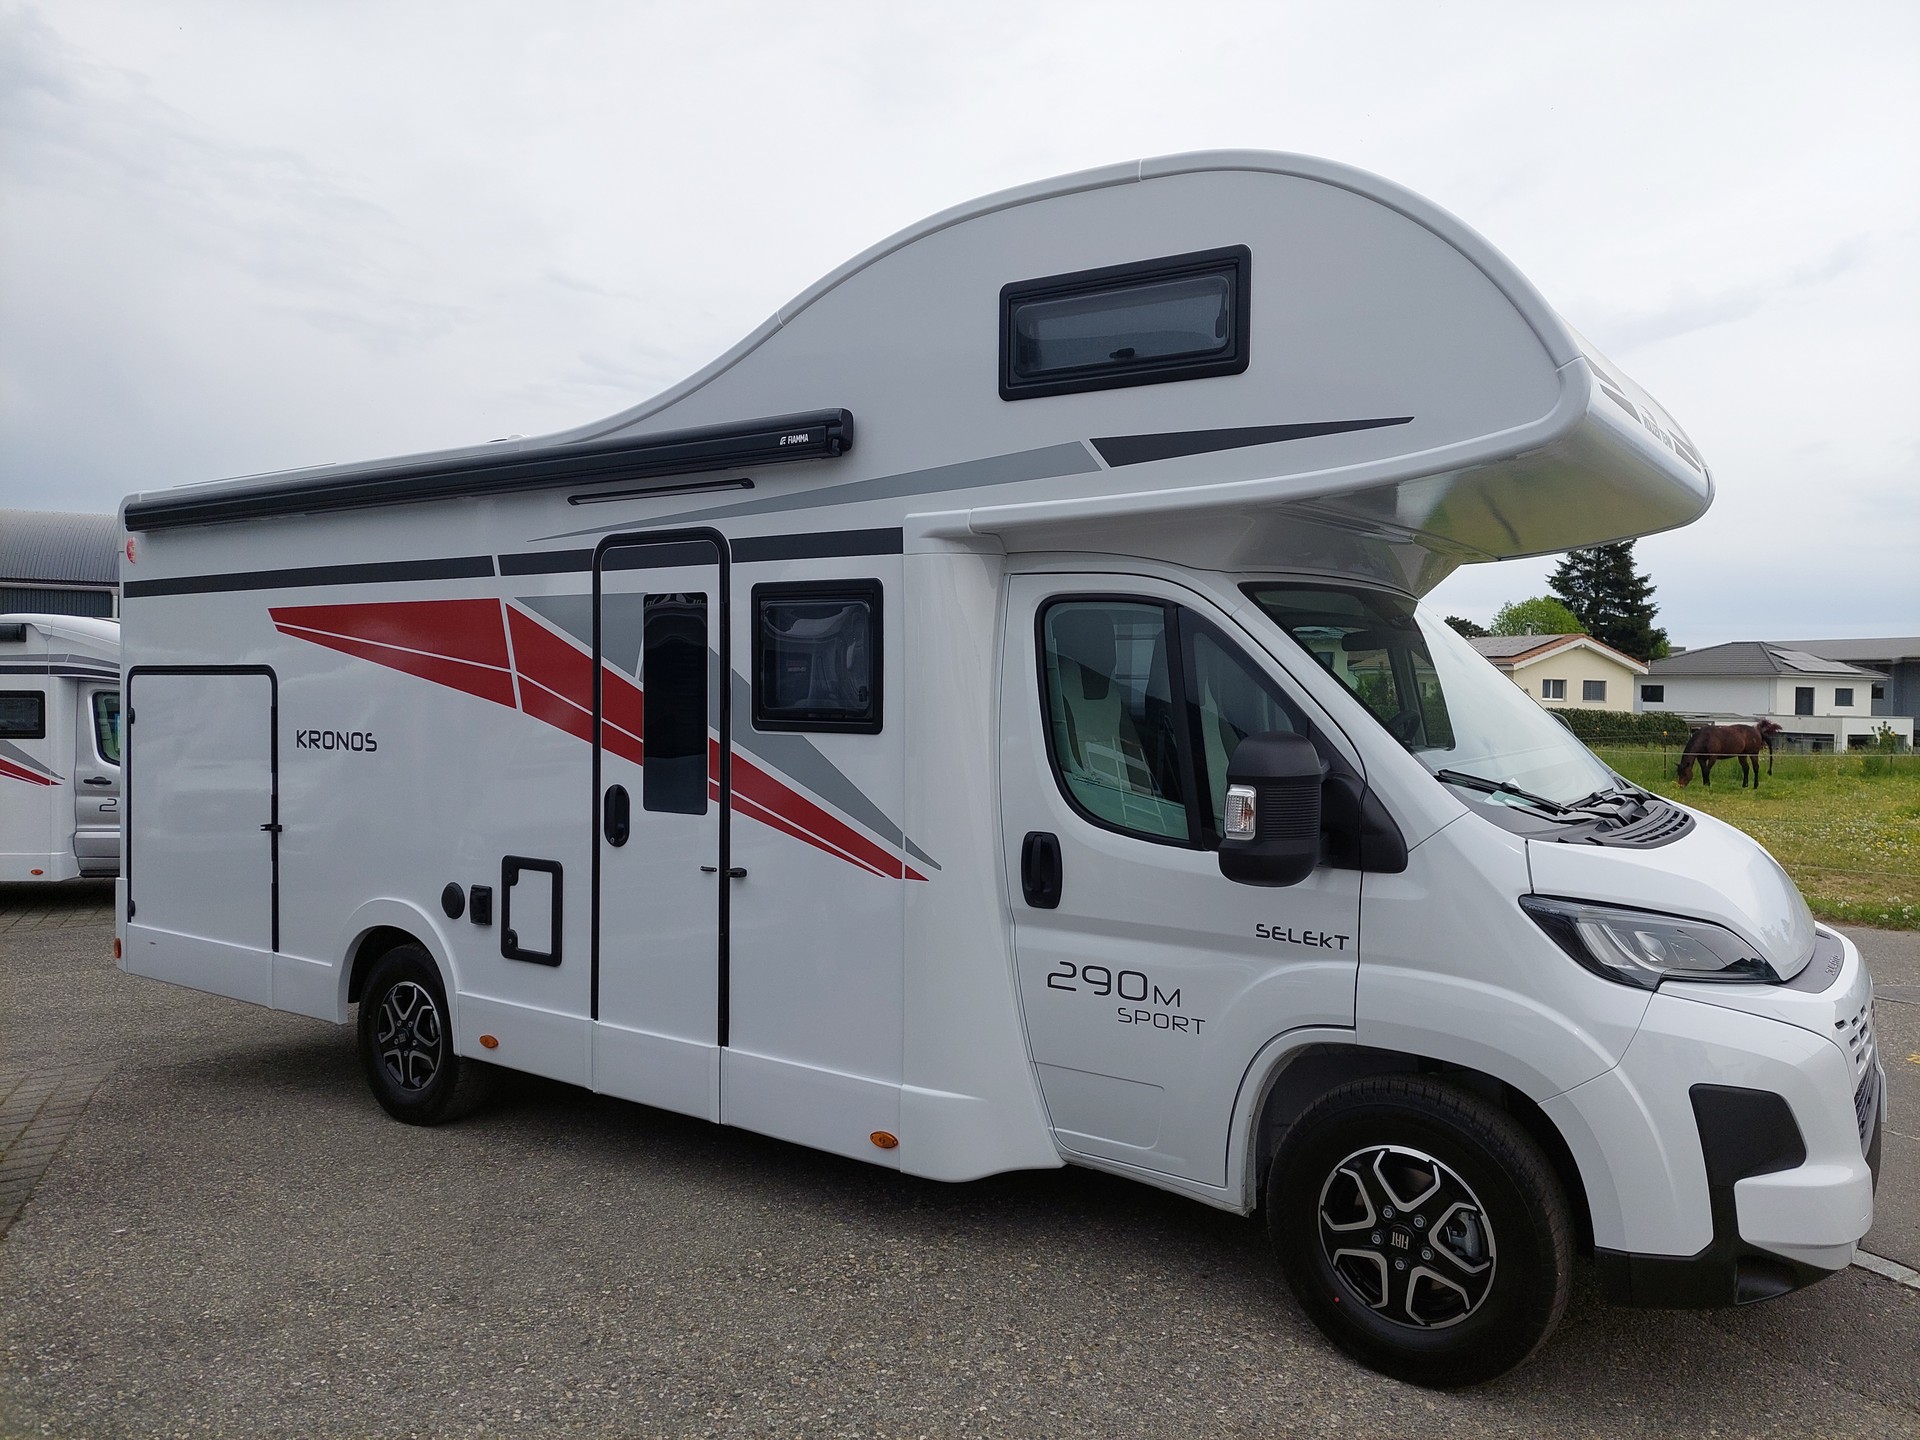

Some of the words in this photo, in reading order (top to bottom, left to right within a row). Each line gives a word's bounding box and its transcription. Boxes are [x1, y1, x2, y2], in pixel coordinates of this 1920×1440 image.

[787, 433, 809, 445] FIAMMA
[296, 729, 378, 752] KRONOS
[1255, 923, 1350, 951] SELEKT
[1117, 1007, 1206, 1035] SPORT
[1390, 1231, 1409, 1250] FIAT
